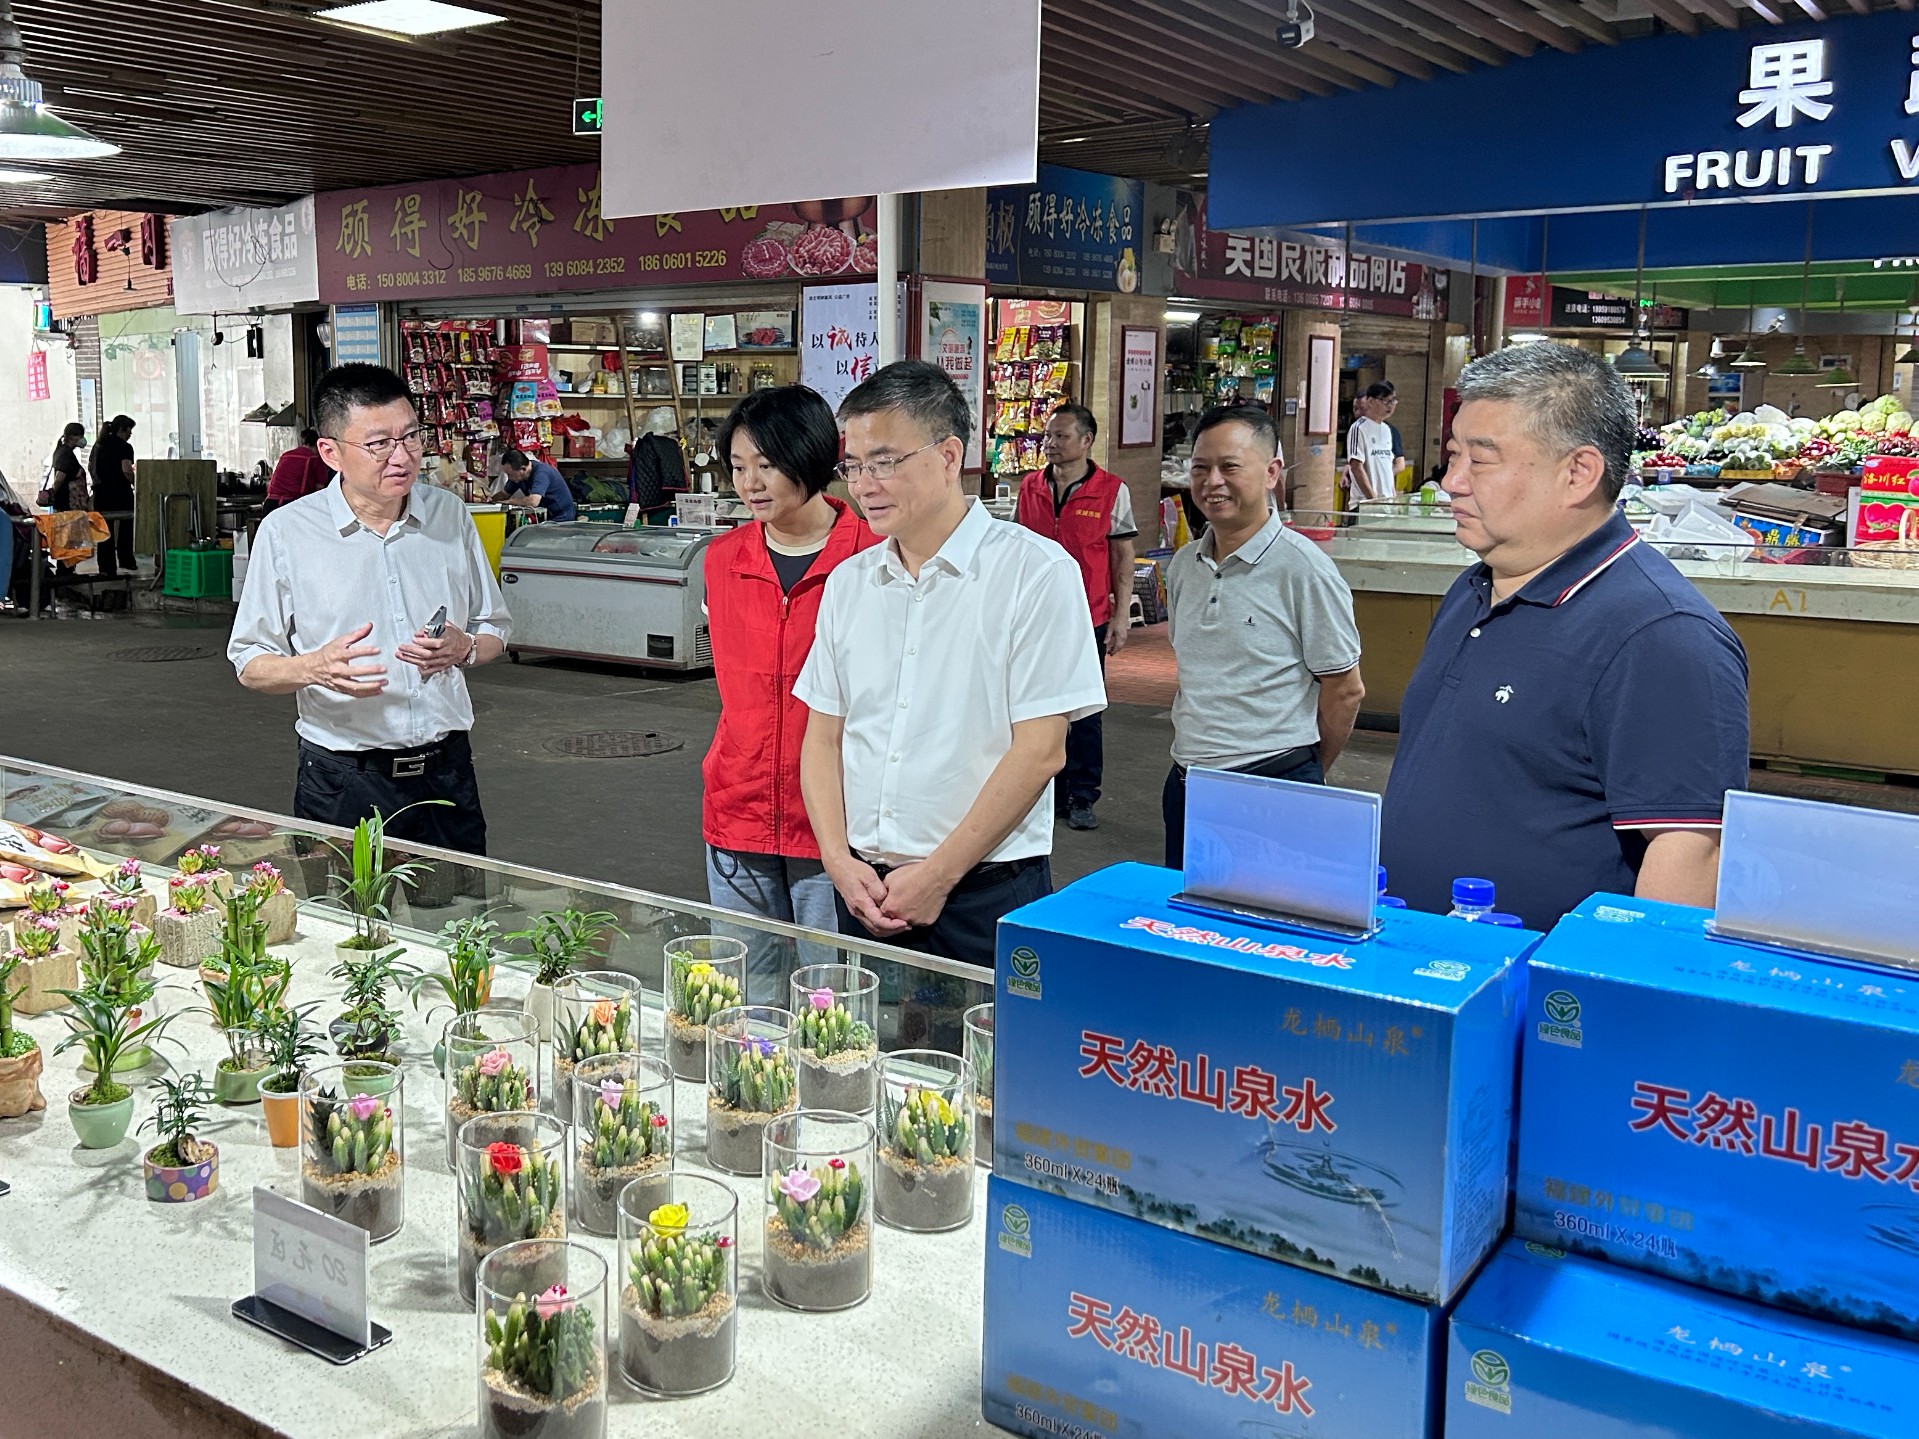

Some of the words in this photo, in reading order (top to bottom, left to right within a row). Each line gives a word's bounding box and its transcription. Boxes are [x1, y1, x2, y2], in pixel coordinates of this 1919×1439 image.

[1736, 38, 1834, 128] 果
[1664, 144, 1833, 193] FRUIT
[335, 171, 761, 259] 顾得好冷冻
[1025, 191, 1133, 245] 顾得好冷冻食品
[202, 212, 298, 273] 顾得好冷冻食品
[377, 272, 394, 288] 150
[396, 271, 420, 286] 8004
[422, 270, 446, 285] 3312
[457, 267, 476, 283] 185
[478, 266, 504, 282] 9676
[506, 264, 532, 279] 4669
[544, 262, 564, 278] 139
[567, 260, 594, 276] 6084
[597, 257, 625, 274] 2352
[639, 255, 660, 271] 186
[663, 253, 692, 269] 0601
[696, 250, 727, 267] 5226
[836, 352, 879, 383] 以信
[1119, 915, 1357, 971] 天然山泉水
[1077, 1028, 1338, 1135] 天然山泉水
[1024, 1152, 1068, 1180] 360ml
[1554, 1210, 1611, 1241] 360ml
[1067, 1290, 1315, 1418] 天然山泉水
[1015, 1402, 1057, 1434] 360ml
